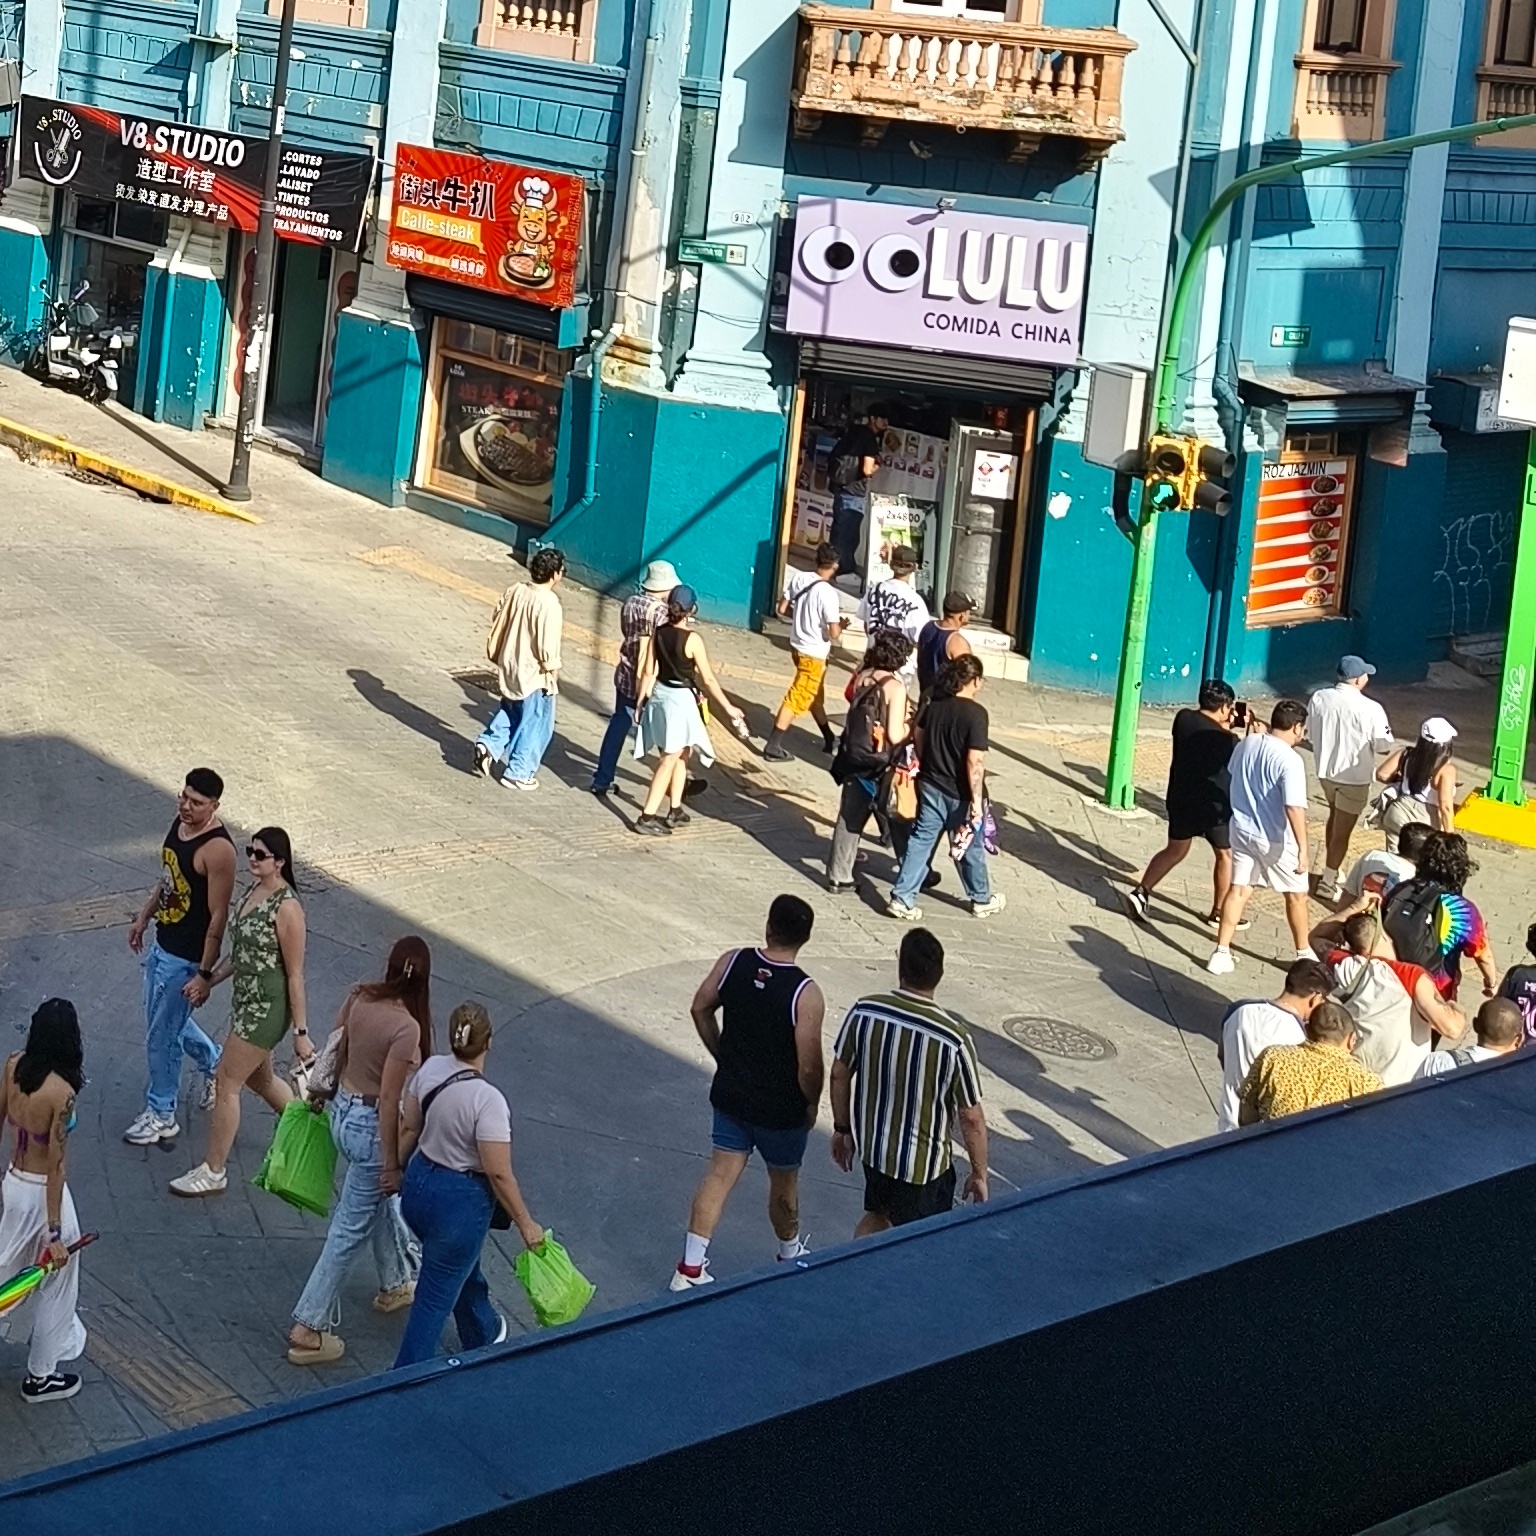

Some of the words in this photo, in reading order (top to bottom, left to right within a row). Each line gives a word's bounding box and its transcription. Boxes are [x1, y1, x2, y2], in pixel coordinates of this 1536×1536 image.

[120, 118, 245, 168] V8.STUDIO
[136, 158, 216, 193] 造型工作室
[400, 173, 496, 222] 街头牛扒
[401, 209, 475, 241] Calle-steak
[923, 312, 1001, 337] COMIDA
[1011, 322, 1072, 345] CHINA
[1288, 461, 1327, 477] JAZMIN
